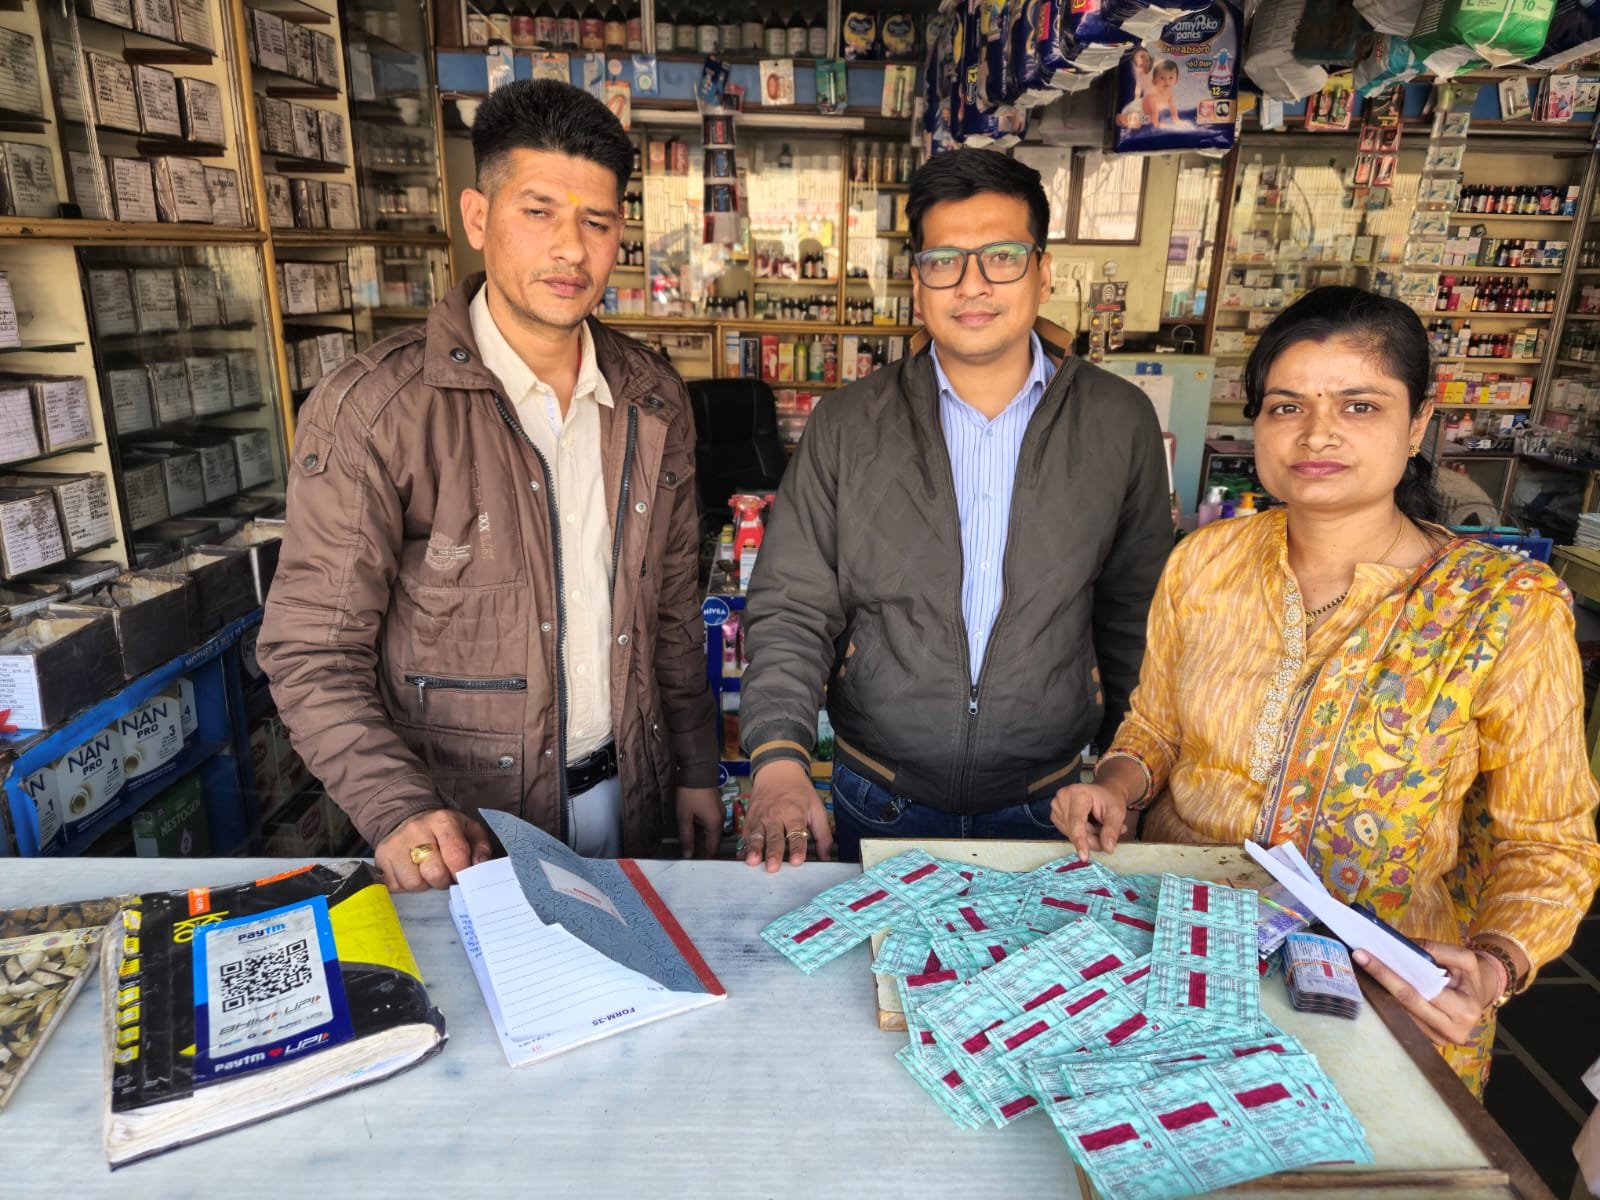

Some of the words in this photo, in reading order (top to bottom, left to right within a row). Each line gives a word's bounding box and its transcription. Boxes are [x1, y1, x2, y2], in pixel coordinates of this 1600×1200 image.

[1175, 30, 1201, 41] pants
[1211, 86, 1221, 95] 12
[703, 607, 727, 616] NIVEA
[121, 702, 168, 736] NAN
[136, 723, 159, 739] PRO
[168, 724, 176, 737] 3
[68, 735, 110, 773] NAN
[82, 758, 103, 776] PRO
[111, 758, 119, 771] 2
[48, 799, 54, 811] 1
[238, 923, 285, 941] Paytm
[592, 1006, 636, 1027] FORM-35
[214, 1052, 266, 1072] Paytm
